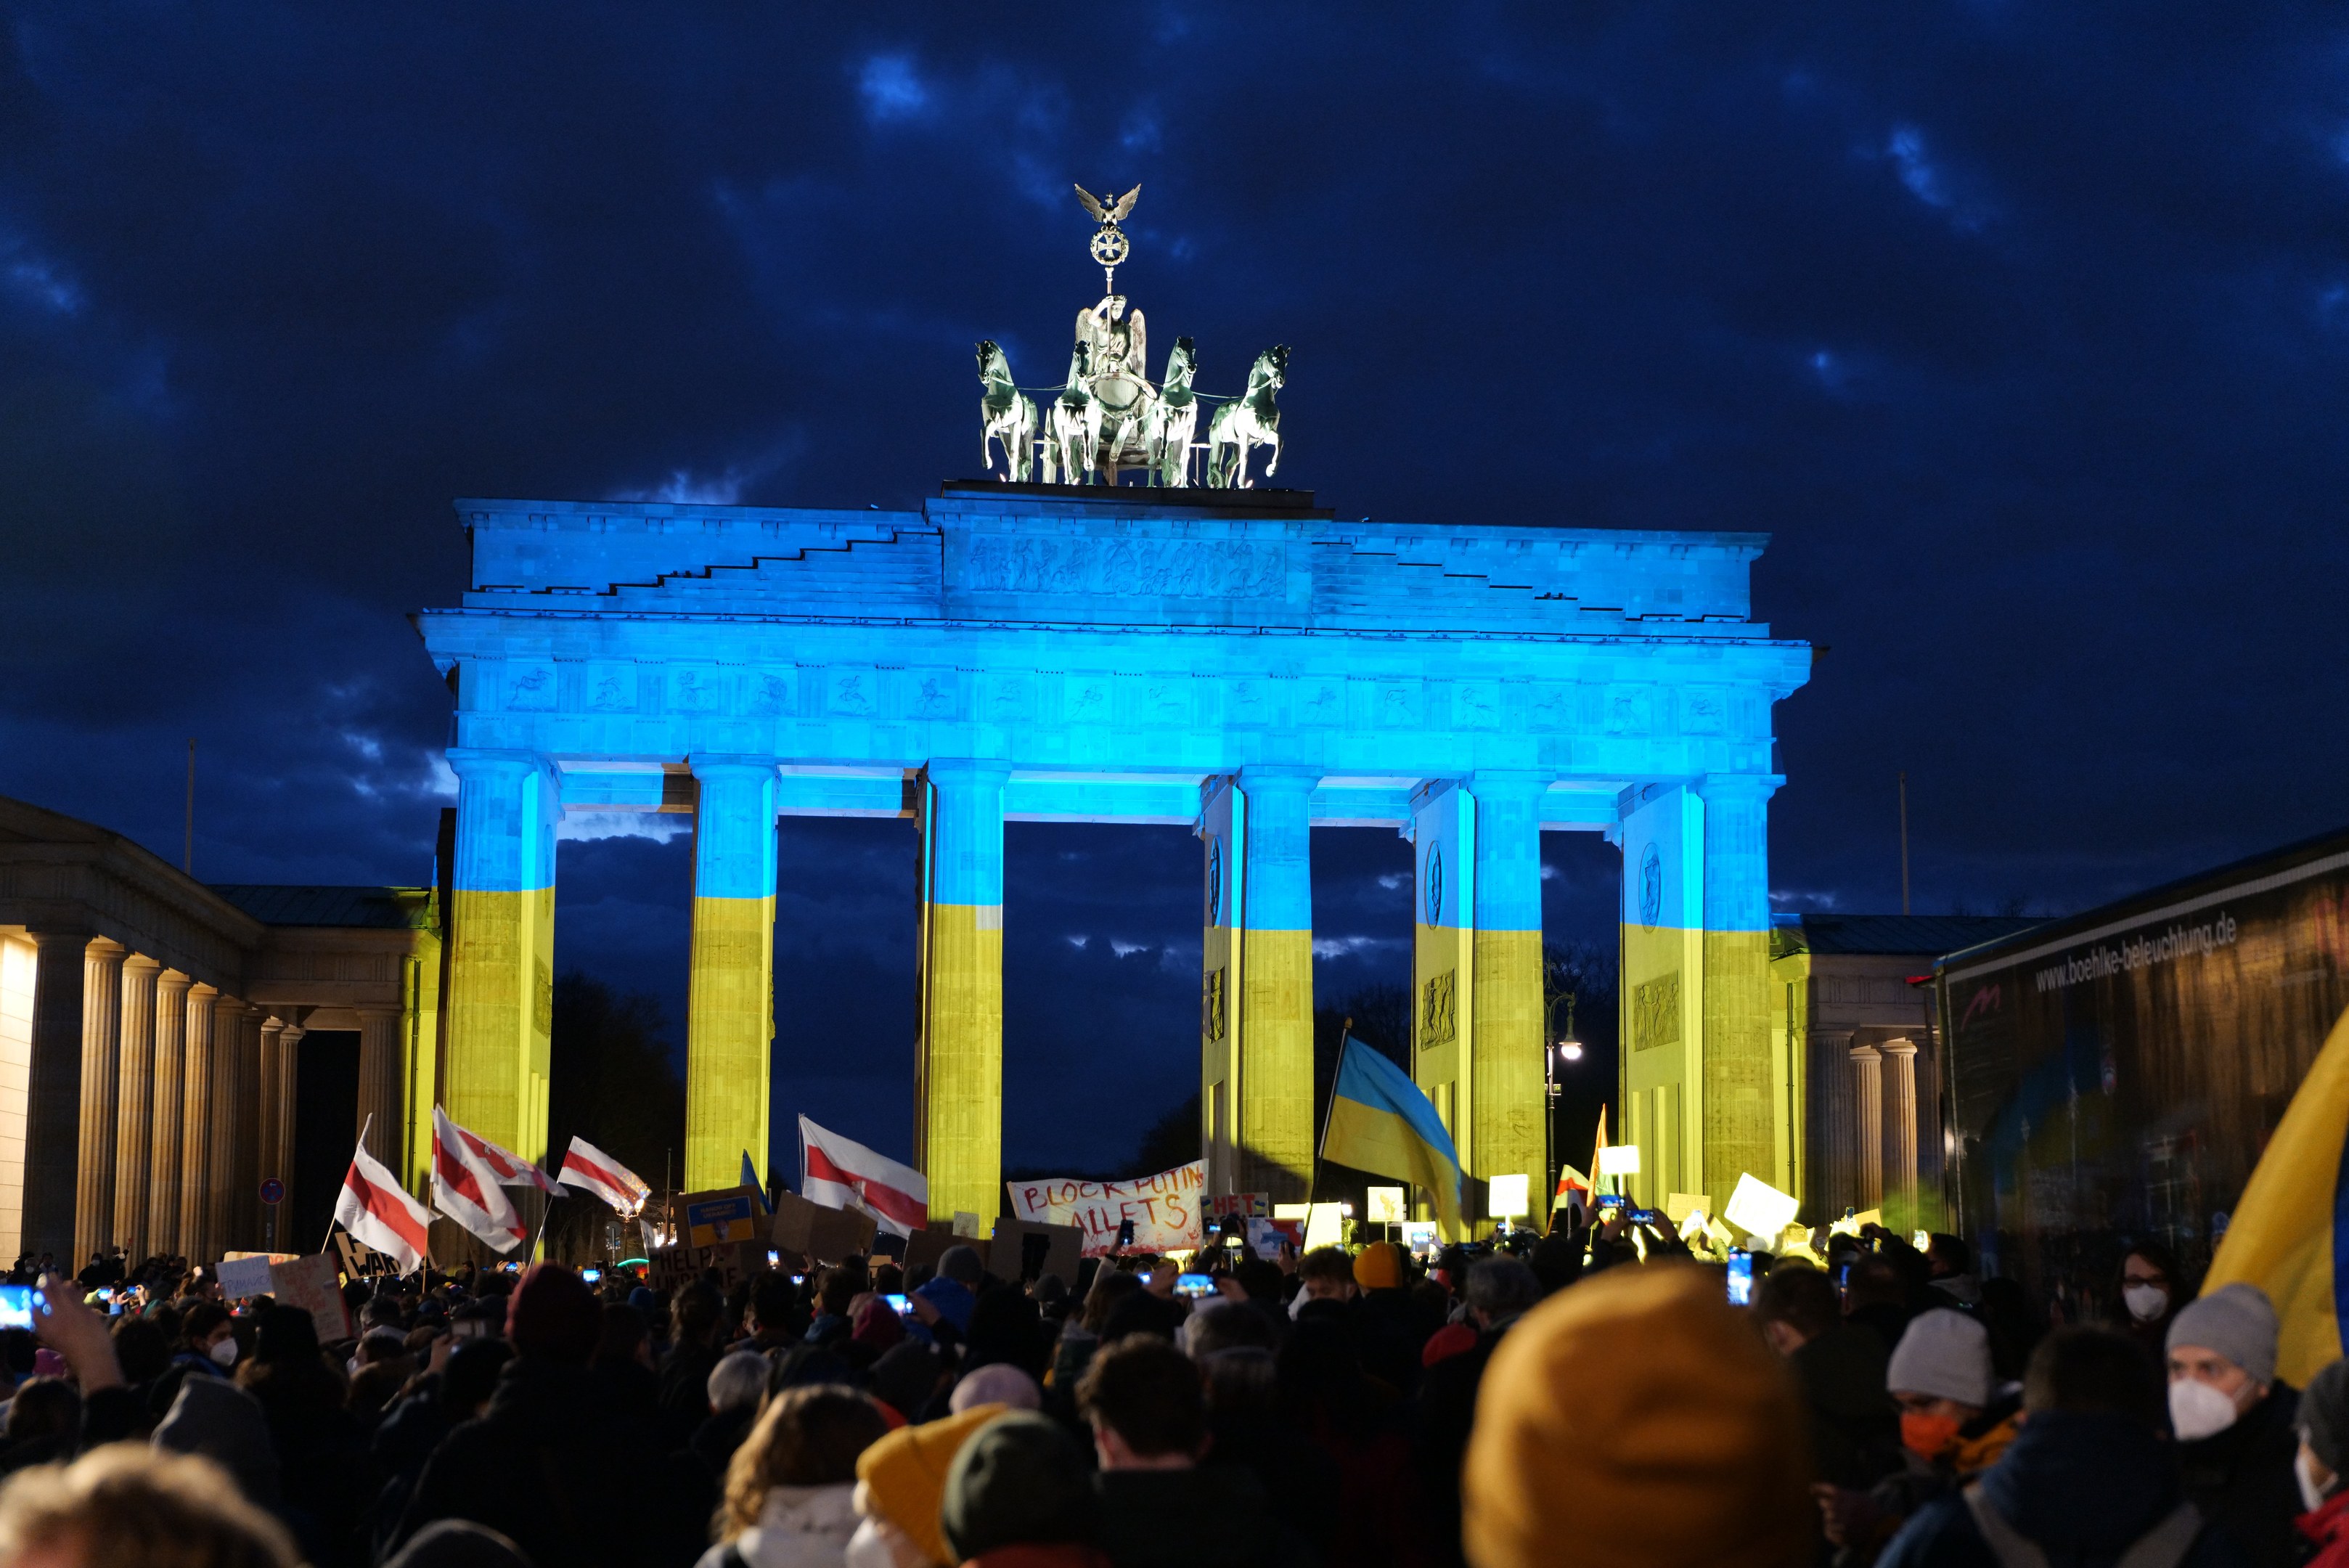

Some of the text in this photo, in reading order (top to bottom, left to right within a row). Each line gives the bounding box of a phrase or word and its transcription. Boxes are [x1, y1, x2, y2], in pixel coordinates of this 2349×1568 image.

[2036, 910, 2236, 992] www.boehlke-beleuchtung.de
[1024, 1182, 1127, 1213] BLOCK
[1214, 1194, 1255, 1215] НЕТ
[1069, 1193, 1188, 1235] ALLETS
[659, 1247, 712, 1273] HELP
